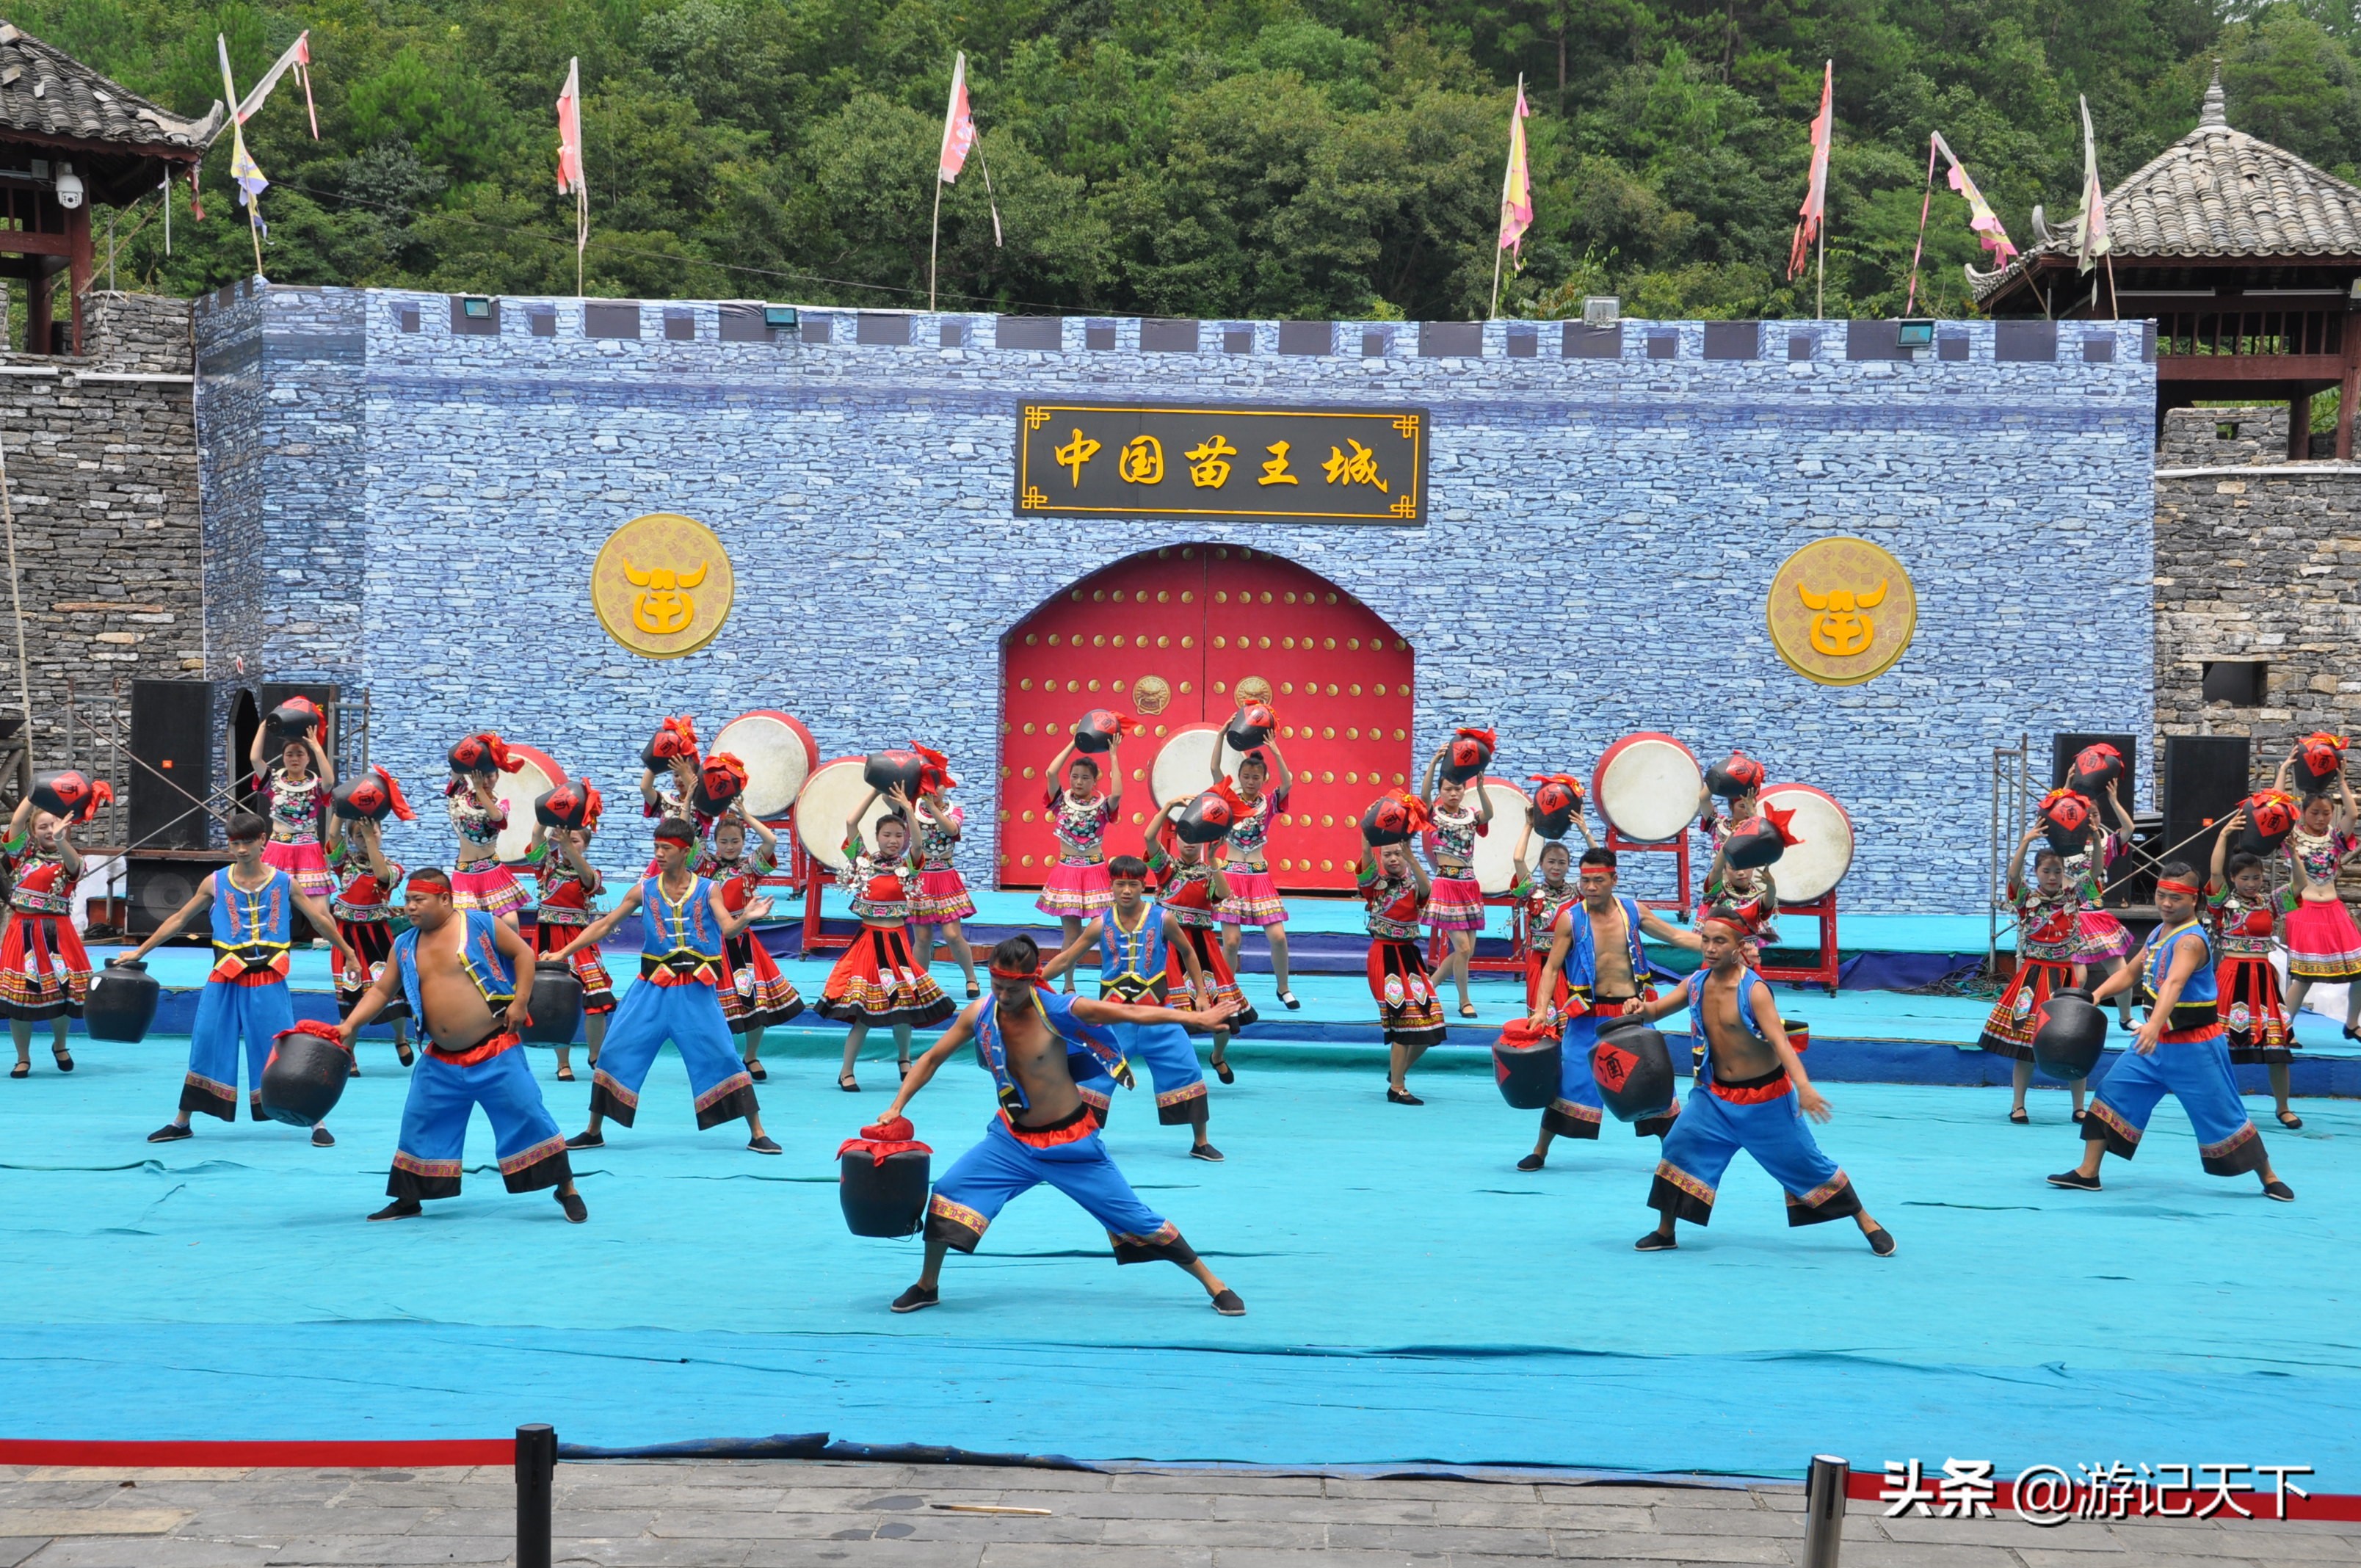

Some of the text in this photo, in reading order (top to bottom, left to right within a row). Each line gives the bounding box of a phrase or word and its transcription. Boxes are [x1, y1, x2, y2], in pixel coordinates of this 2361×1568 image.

[1054, 428, 1388, 493] 中国苗王城
[1454, 744, 1476, 763] 酒
[2081, 752, 2098, 769] 酒
[2312, 752, 2332, 770] 酒
[709, 775, 730, 794] 酒
[357, 788, 377, 806] 酒
[554, 794, 571, 810] 酒
[1542, 788, 1559, 808] 酒
[1381, 808, 1401, 827] 酒
[2059, 803, 2078, 821] 酒
[2261, 808, 2284, 832] 酒
[1597, 1050, 1625, 1084] 酒
